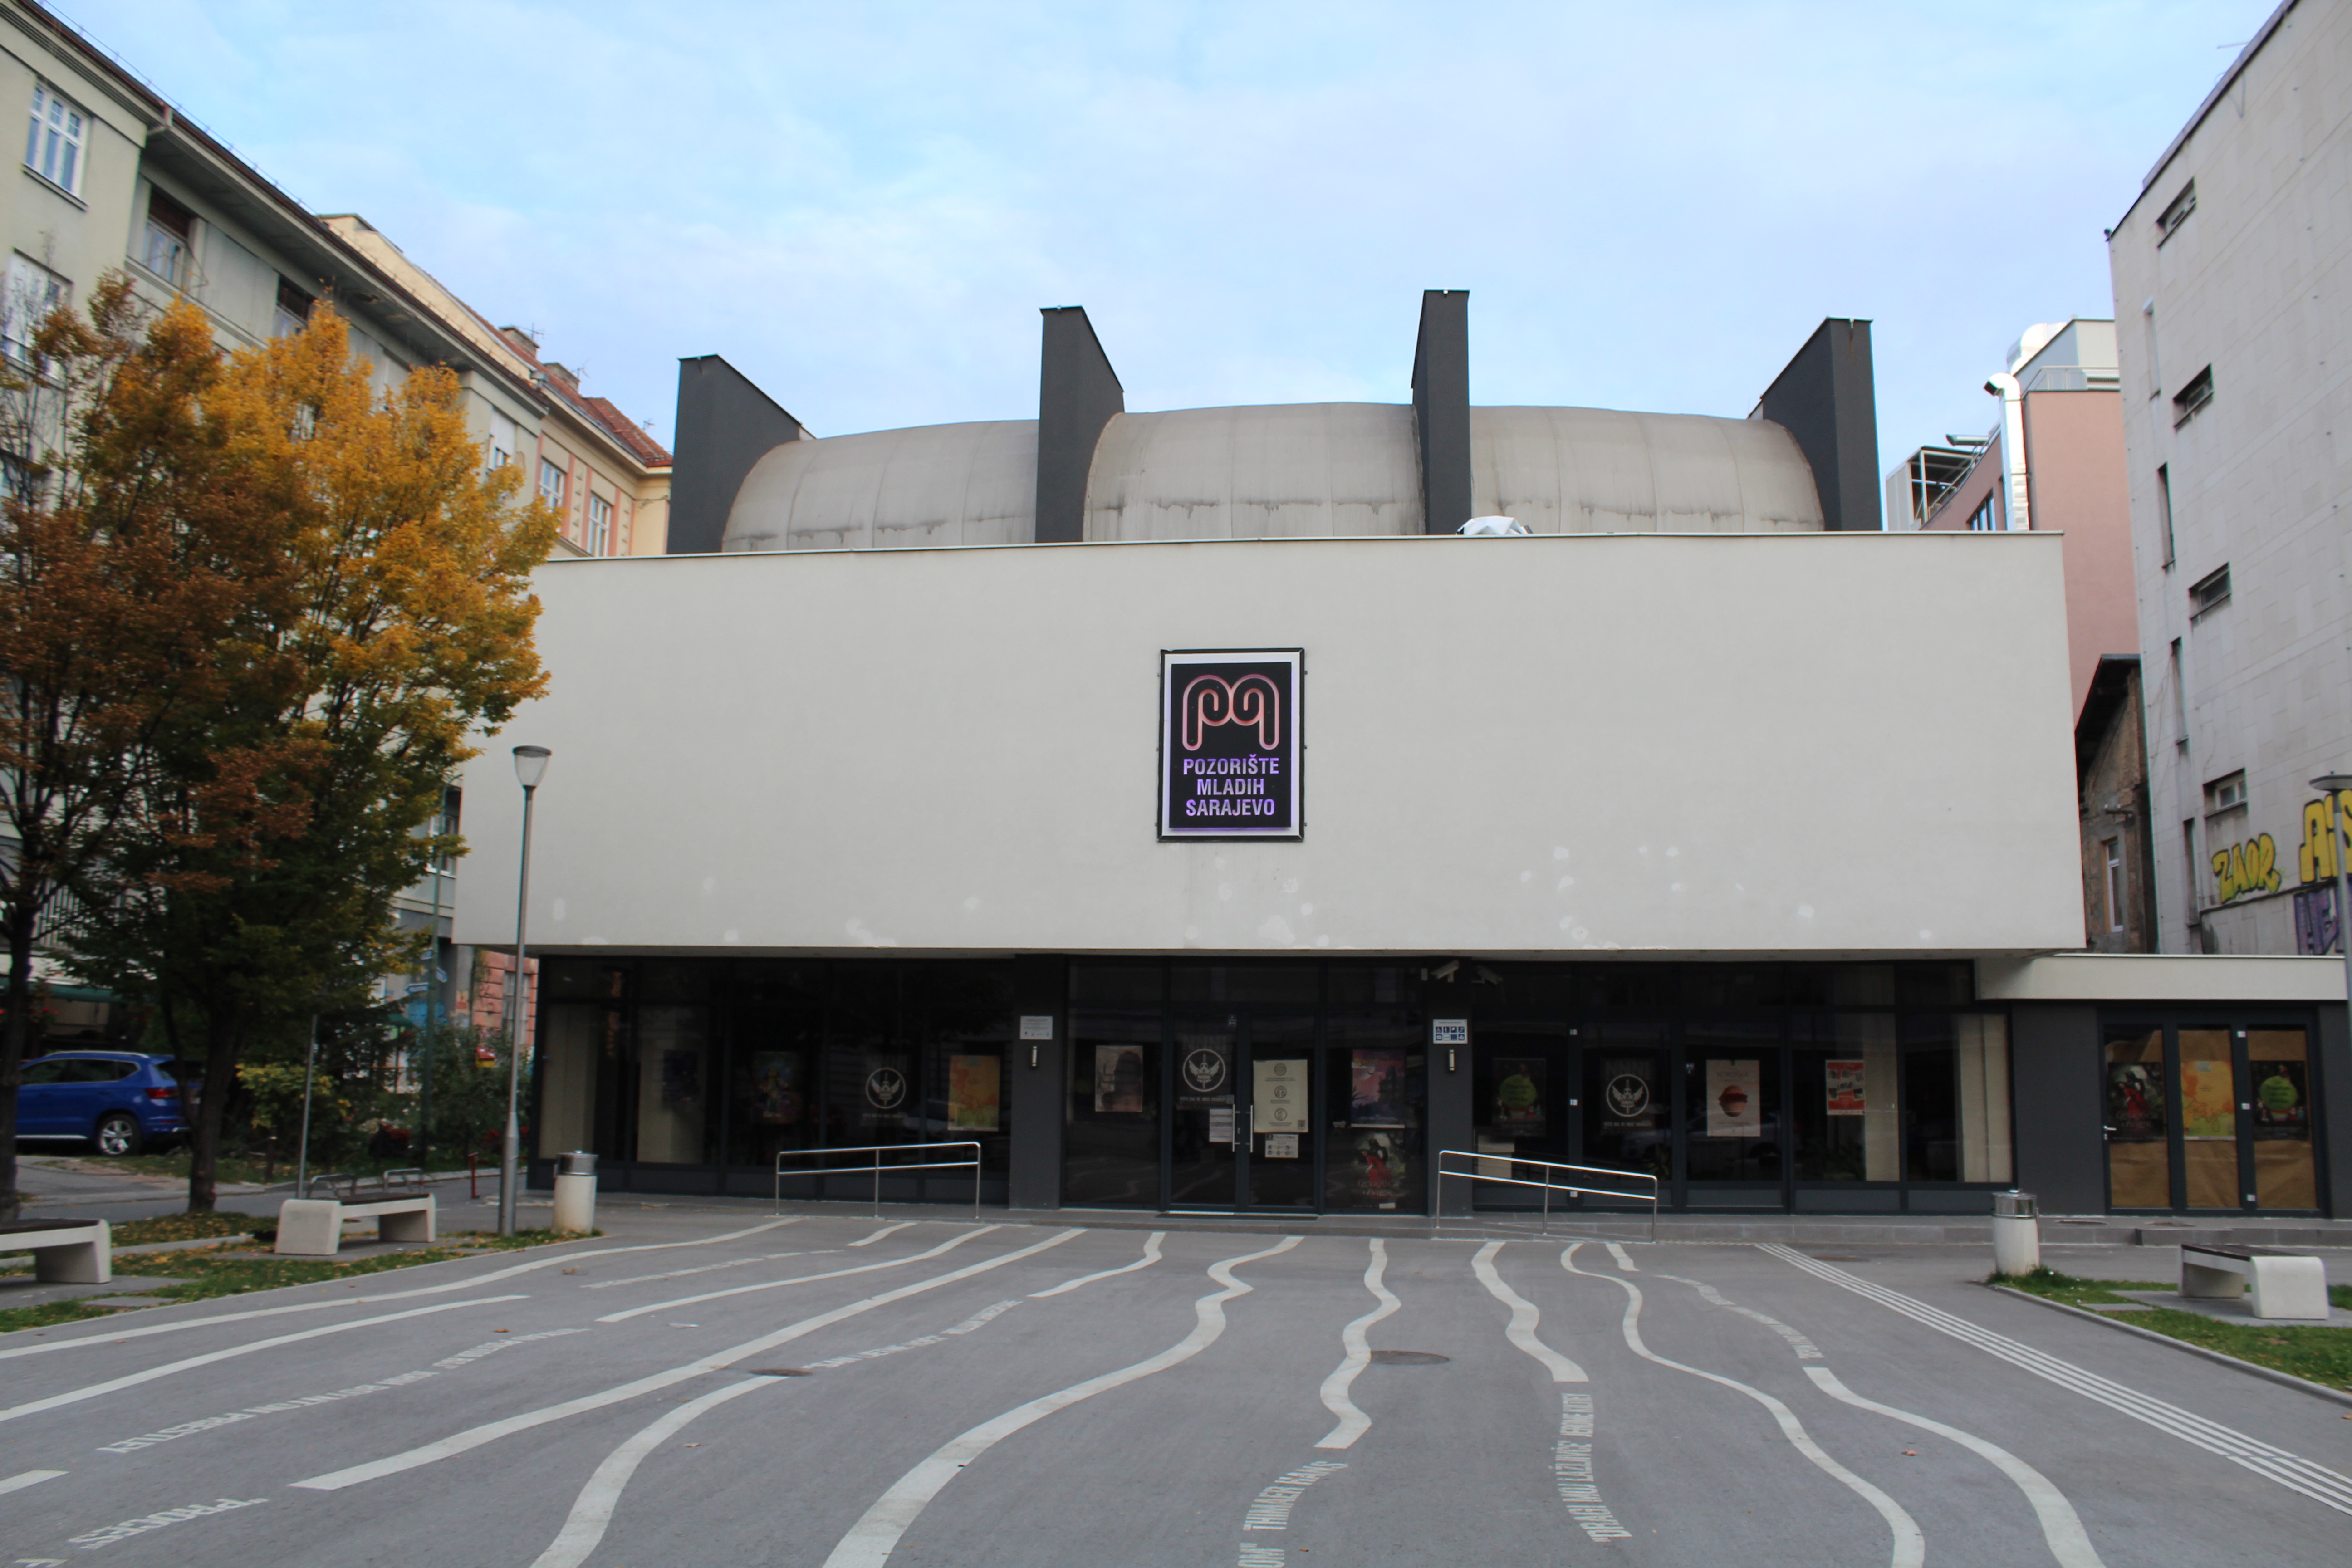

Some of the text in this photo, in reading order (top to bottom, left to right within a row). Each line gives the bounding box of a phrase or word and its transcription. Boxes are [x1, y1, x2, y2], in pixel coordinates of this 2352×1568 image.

[1183, 754, 1279, 775] POZORIŠTE
[1197, 778, 1264, 795] MLADIH
[1186, 799, 1275, 816] SARAJEVO
[1557, 1483, 1602, 1503] MOJ
[1566, 1505, 1632, 1542] "DRAGI
